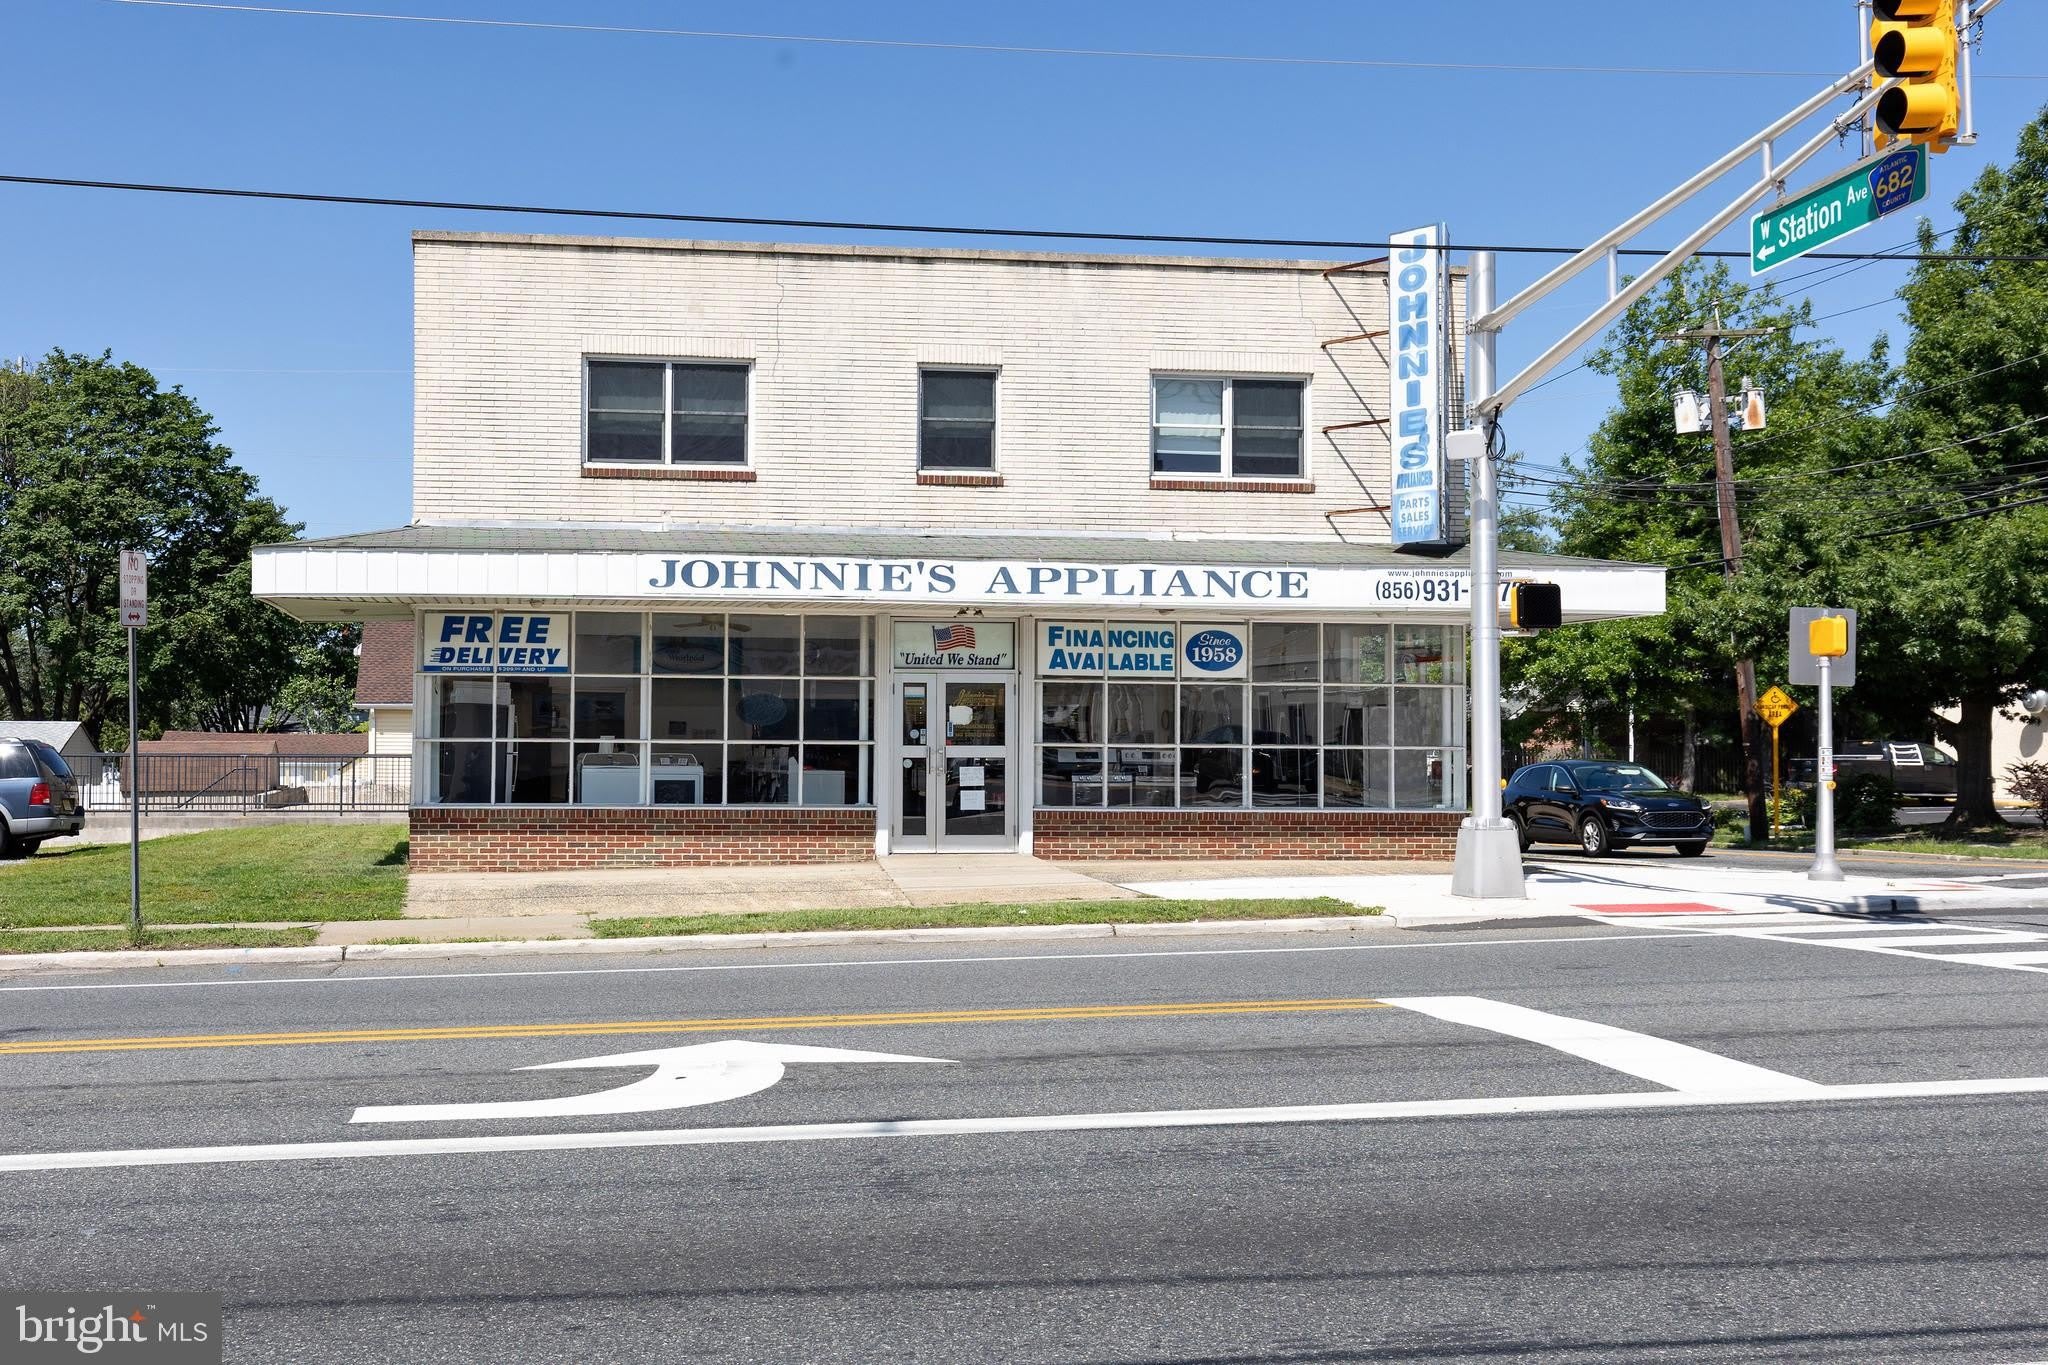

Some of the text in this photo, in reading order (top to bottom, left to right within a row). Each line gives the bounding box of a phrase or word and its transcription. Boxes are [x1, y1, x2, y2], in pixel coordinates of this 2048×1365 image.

[1876, 165, 1913, 199] 682
[1882, 191, 1906, 208] COUNTY
[1760, 186, 1868, 248] W Station Ave
[1400, 496, 1430, 509] PARTS
[1400, 511, 1430, 524] SALES
[127, 556, 139, 571] NO
[123, 574, 144, 584] STOPPING
[649, 559, 1309, 599] JOHNNIE'S APPLIANCE
[123, 599, 144, 609] STANDING
[440, 615, 551, 644] FREE
[1048, 625, 1175, 649] FINANCING
[1198, 633, 1232, 647] Since
[438, 647, 561, 664] DELIVERY
[947, 653, 964, 665] We
[1048, 648, 1174, 671] AVAILABLE
[1191, 646, 1237, 664] 1958
